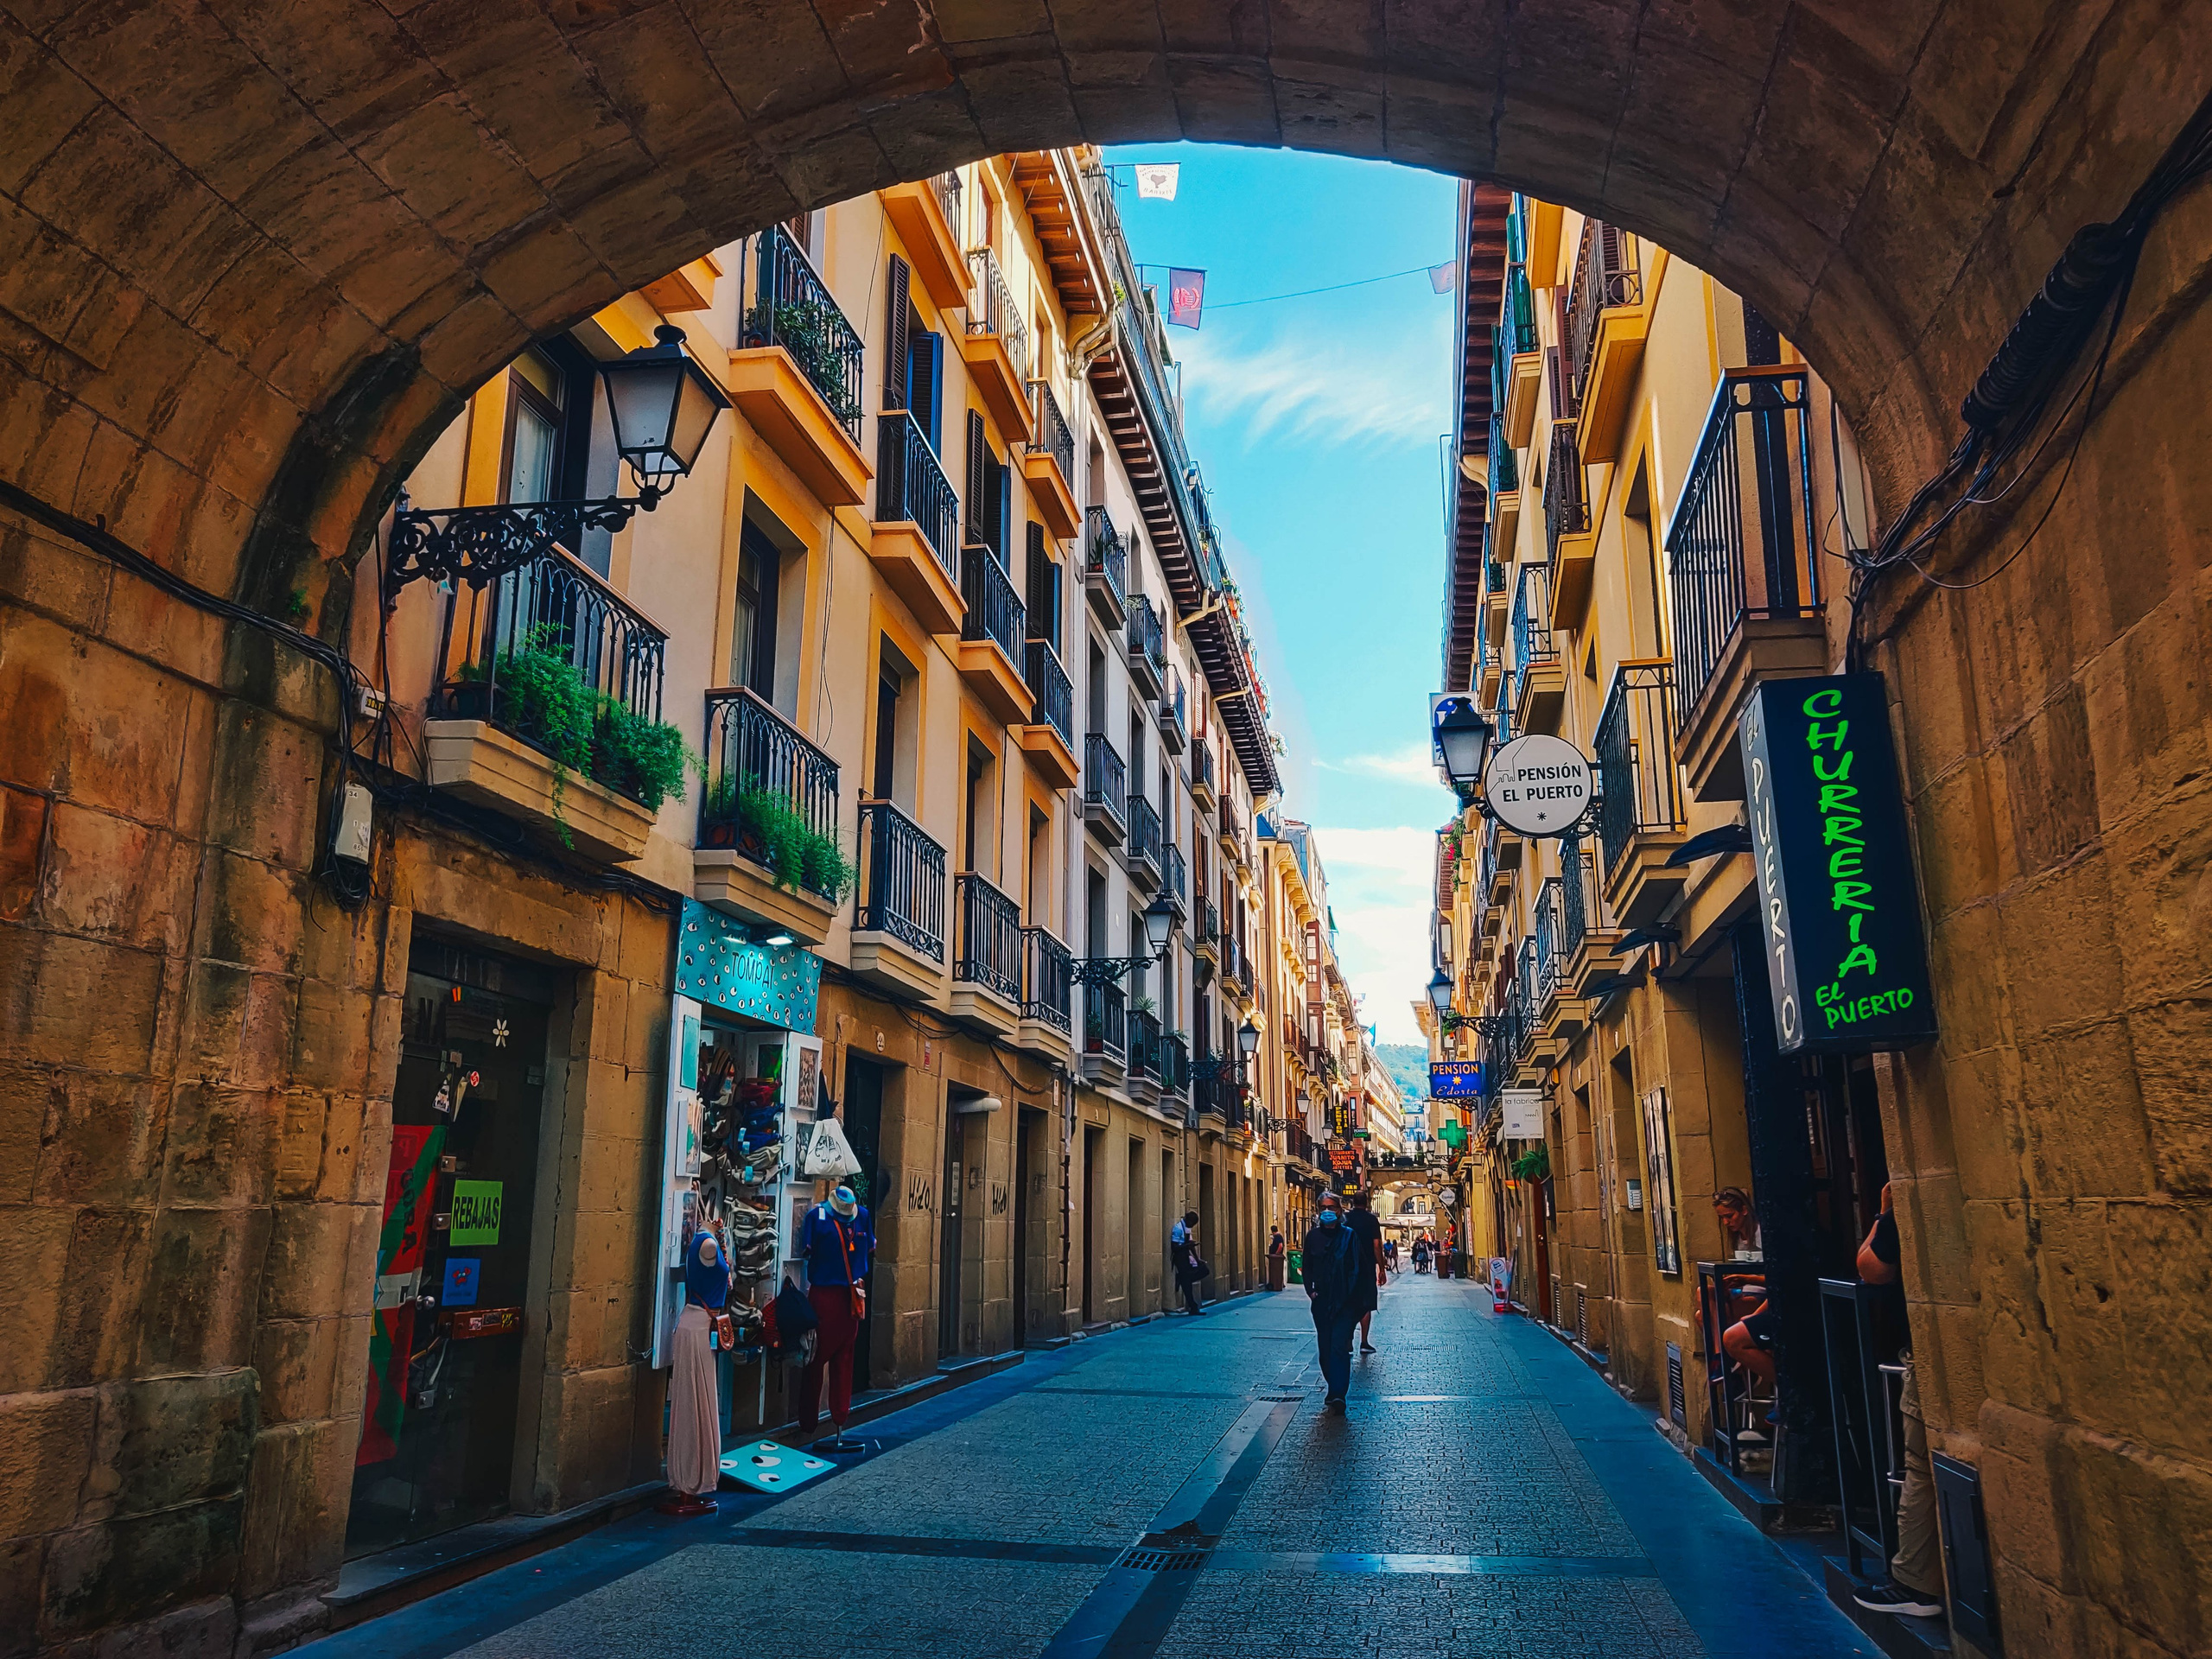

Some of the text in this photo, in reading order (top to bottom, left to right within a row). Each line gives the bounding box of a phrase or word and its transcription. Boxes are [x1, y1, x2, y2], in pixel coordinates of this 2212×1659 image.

[1517, 762, 1581, 781] PENSIÓN
[1503, 784, 1583, 803] EL PUERTO
[1802, 689, 1878, 979] CHURRERIA
[1751, 757, 1796, 1038] PUERTO
[1816, 982, 1845, 1007] El
[1826, 987, 1914, 1030] PUERTO
[1433, 1064, 1478, 1075] PENSION
[1436, 1086, 1478, 1096] Edorta
[452, 1196, 499, 1230] REBAJAS
